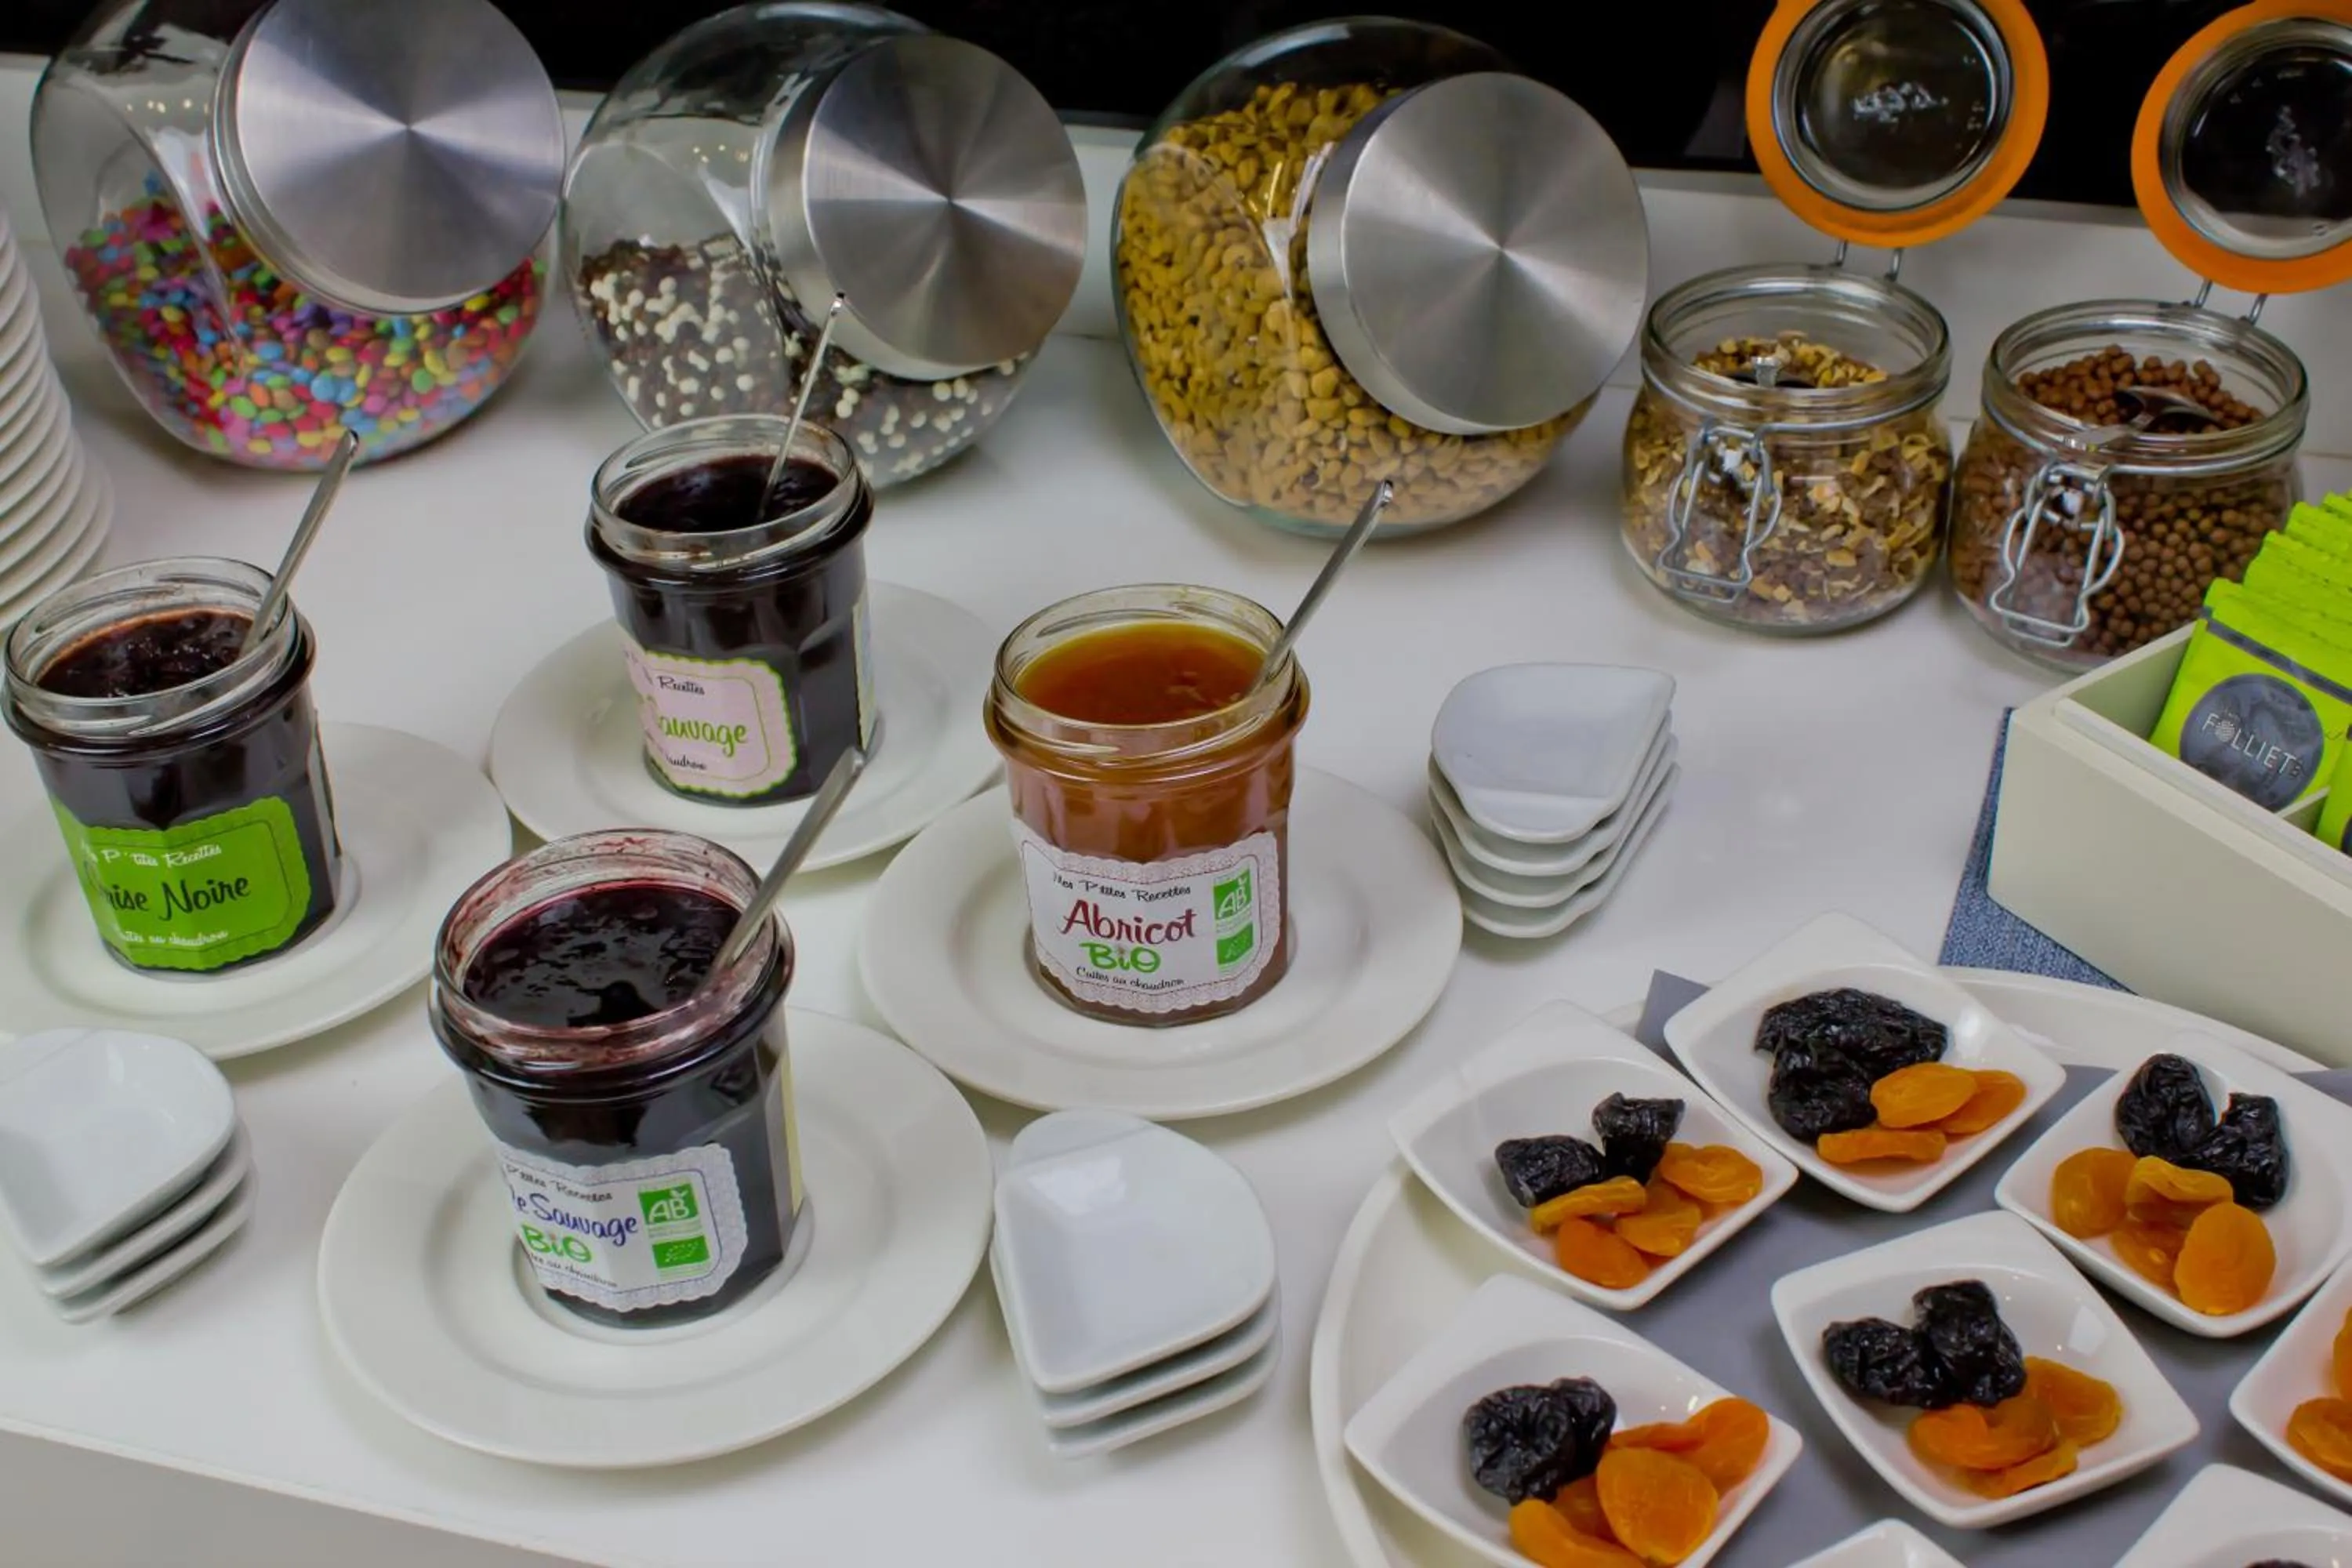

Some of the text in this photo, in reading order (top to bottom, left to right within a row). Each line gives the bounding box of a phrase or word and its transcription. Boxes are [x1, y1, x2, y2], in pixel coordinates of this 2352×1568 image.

[659, 716, 747, 757] auvage
[158, 876, 251, 921] Noire
[1131, 885, 1191, 902] Recettes
[1217, 886, 1248, 918] AB
[1057, 898, 1198, 946] Abricot
[529, 1192, 640, 1247] Sauvage
[648, 1198, 691, 1224] AB
